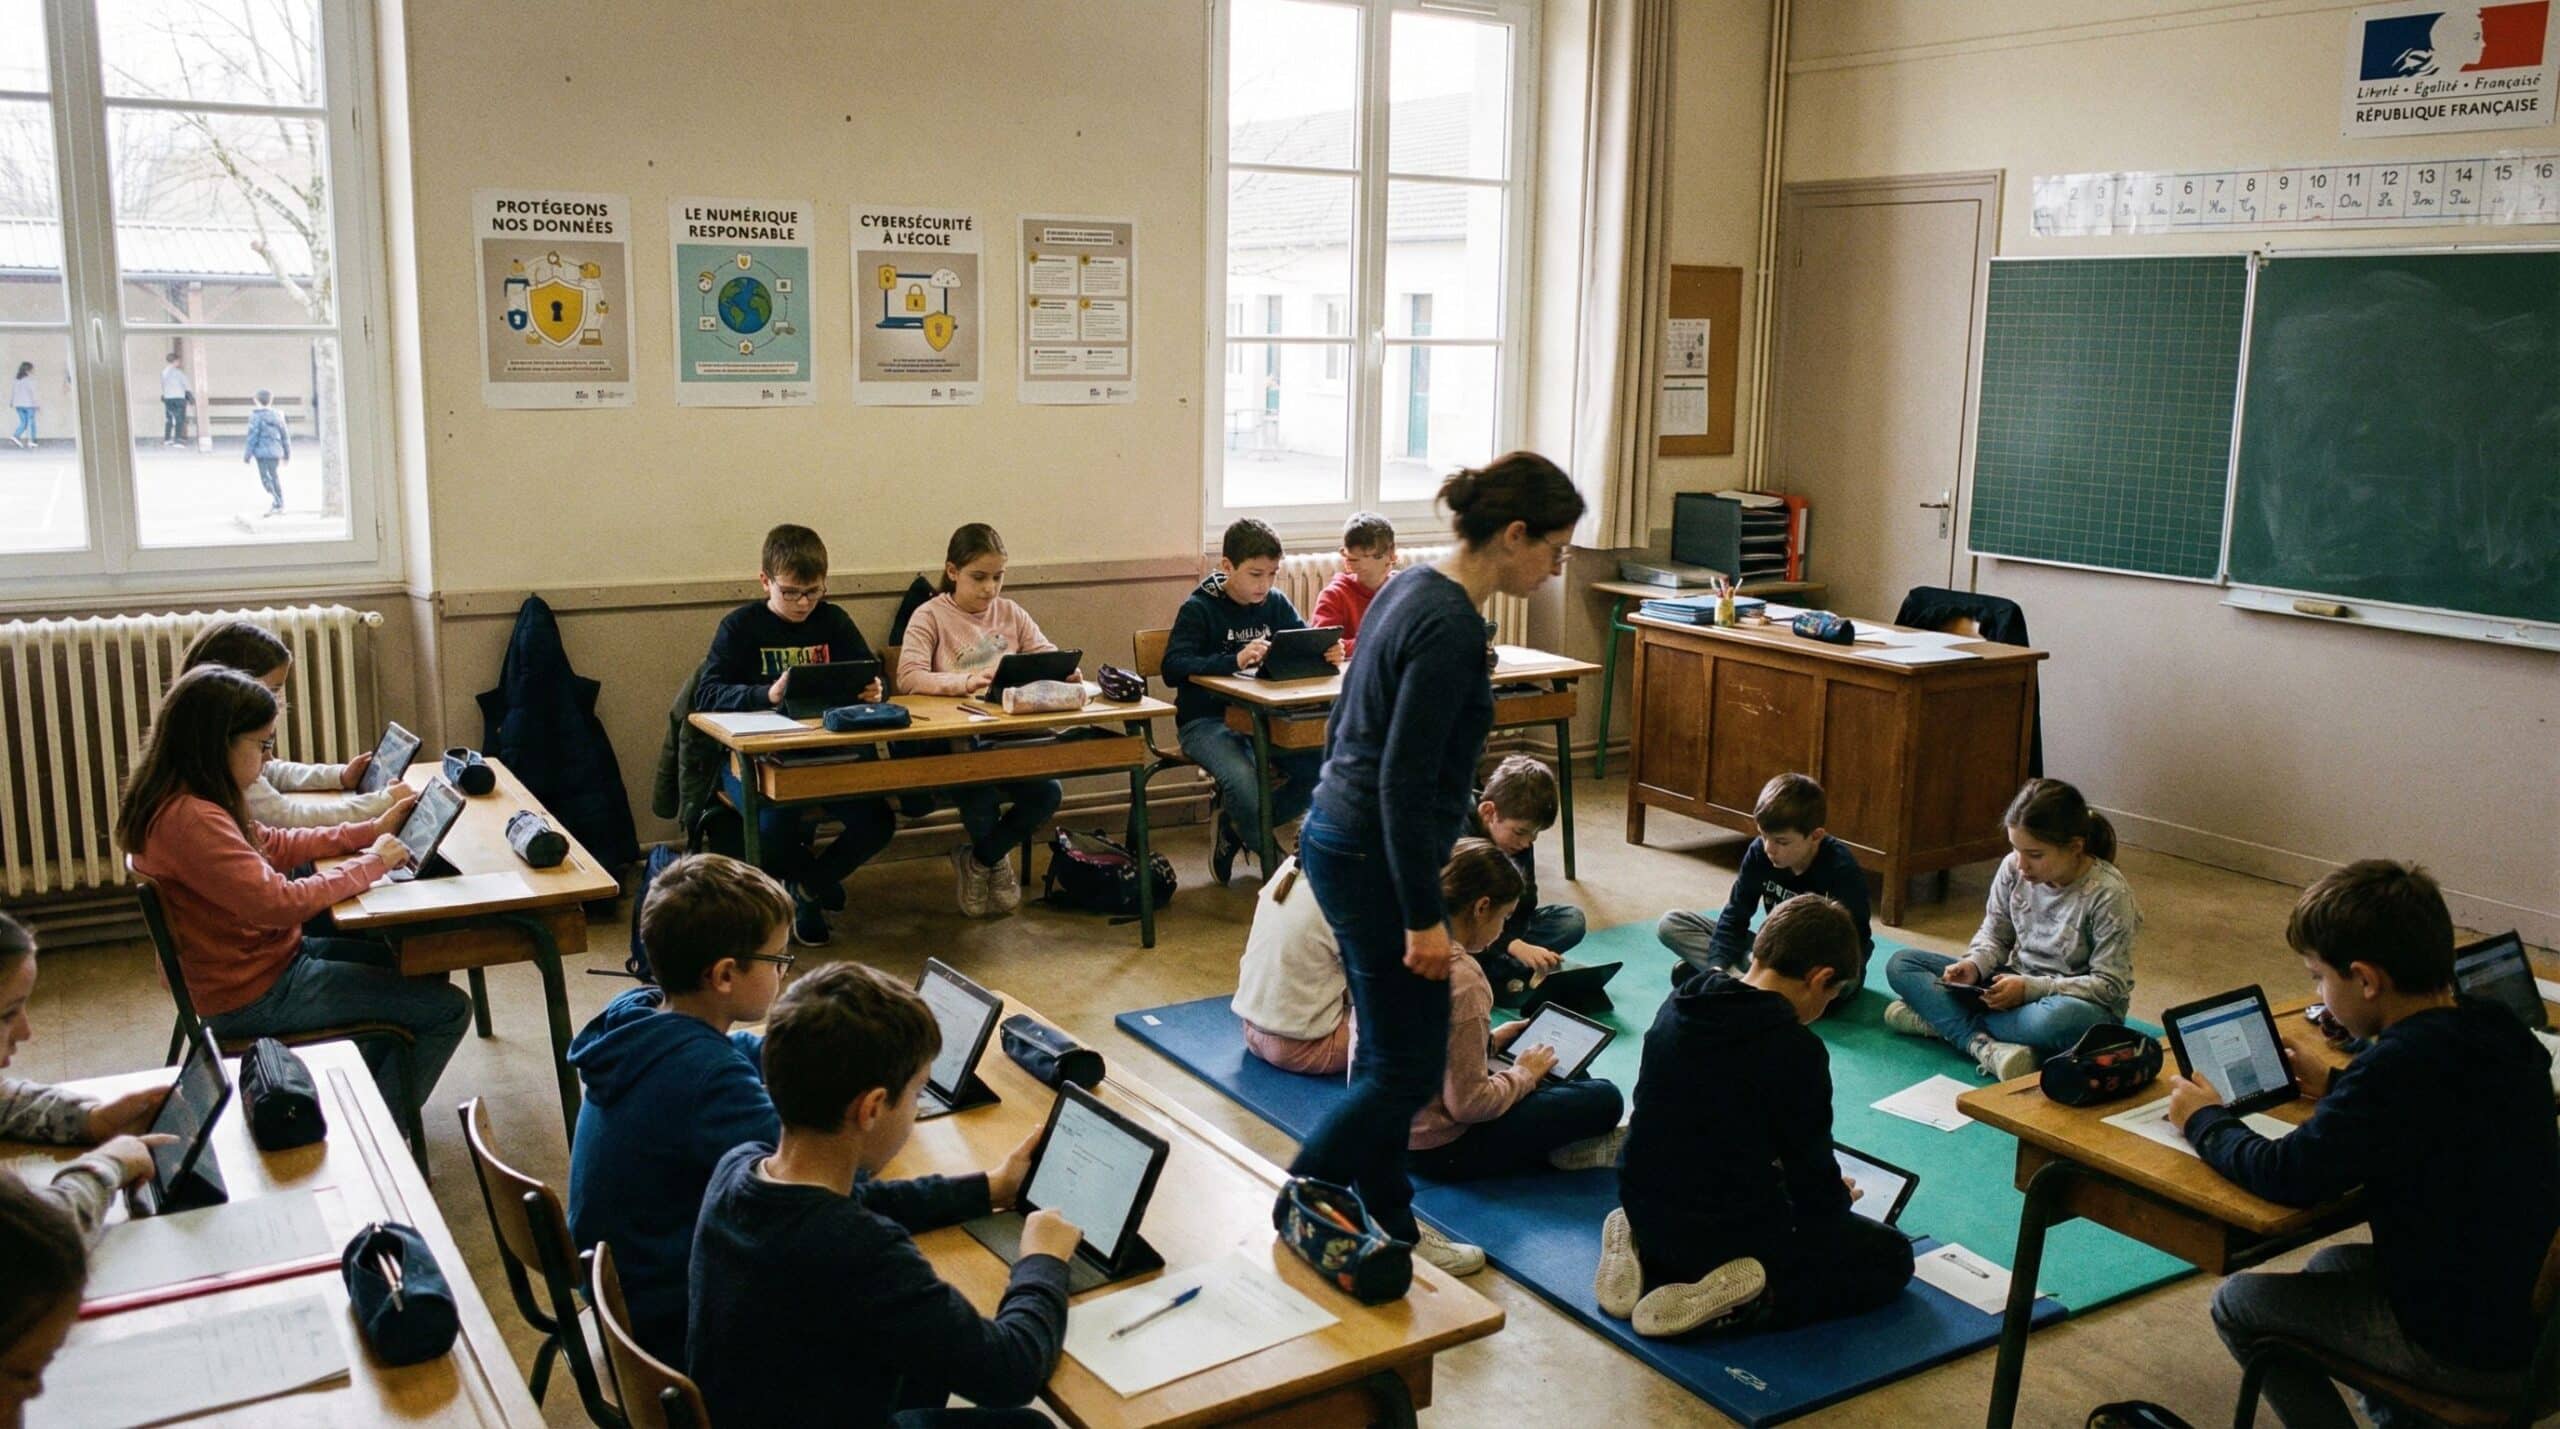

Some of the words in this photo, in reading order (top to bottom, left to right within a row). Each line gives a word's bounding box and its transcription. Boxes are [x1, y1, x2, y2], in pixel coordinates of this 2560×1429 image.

[2355, 105, 2446, 122] RÉPUBLIQUE
[2451, 97, 2539, 116] FRANÇAISE
[2097, 186, 2105, 199] 3
[2155, 183, 2163, 196] 5
[2184, 181, 2193, 195] 6
[2216, 180, 2224, 192] 7
[2246, 178, 2256, 191] 8
[2279, 176, 2289, 190] 9
[2310, 174, 2327, 188] 10
[2346, 173, 2360, 187] 11
[2381, 170, 2398, 185] 12
[2418, 169, 2436, 184] 13
[2456, 167, 2473, 182] 14
[2494, 165, 2512, 180] 15
[2534, 163, 2553, 178] 16
[496, 199, 608, 217] PROTÉGEONS
[685, 207, 702, 220] LE
[706, 206, 798, 226] NUMÉRIQUE
[492, 217, 528, 231] NOS
[533, 218, 613, 234] DONNÉES
[860, 214, 973, 231] CYBERSÉCURITÉ
[688, 225, 795, 240] RESPONSABLE
[882, 229, 893, 244] À
[897, 231, 951, 246] L'ÉCOLE
